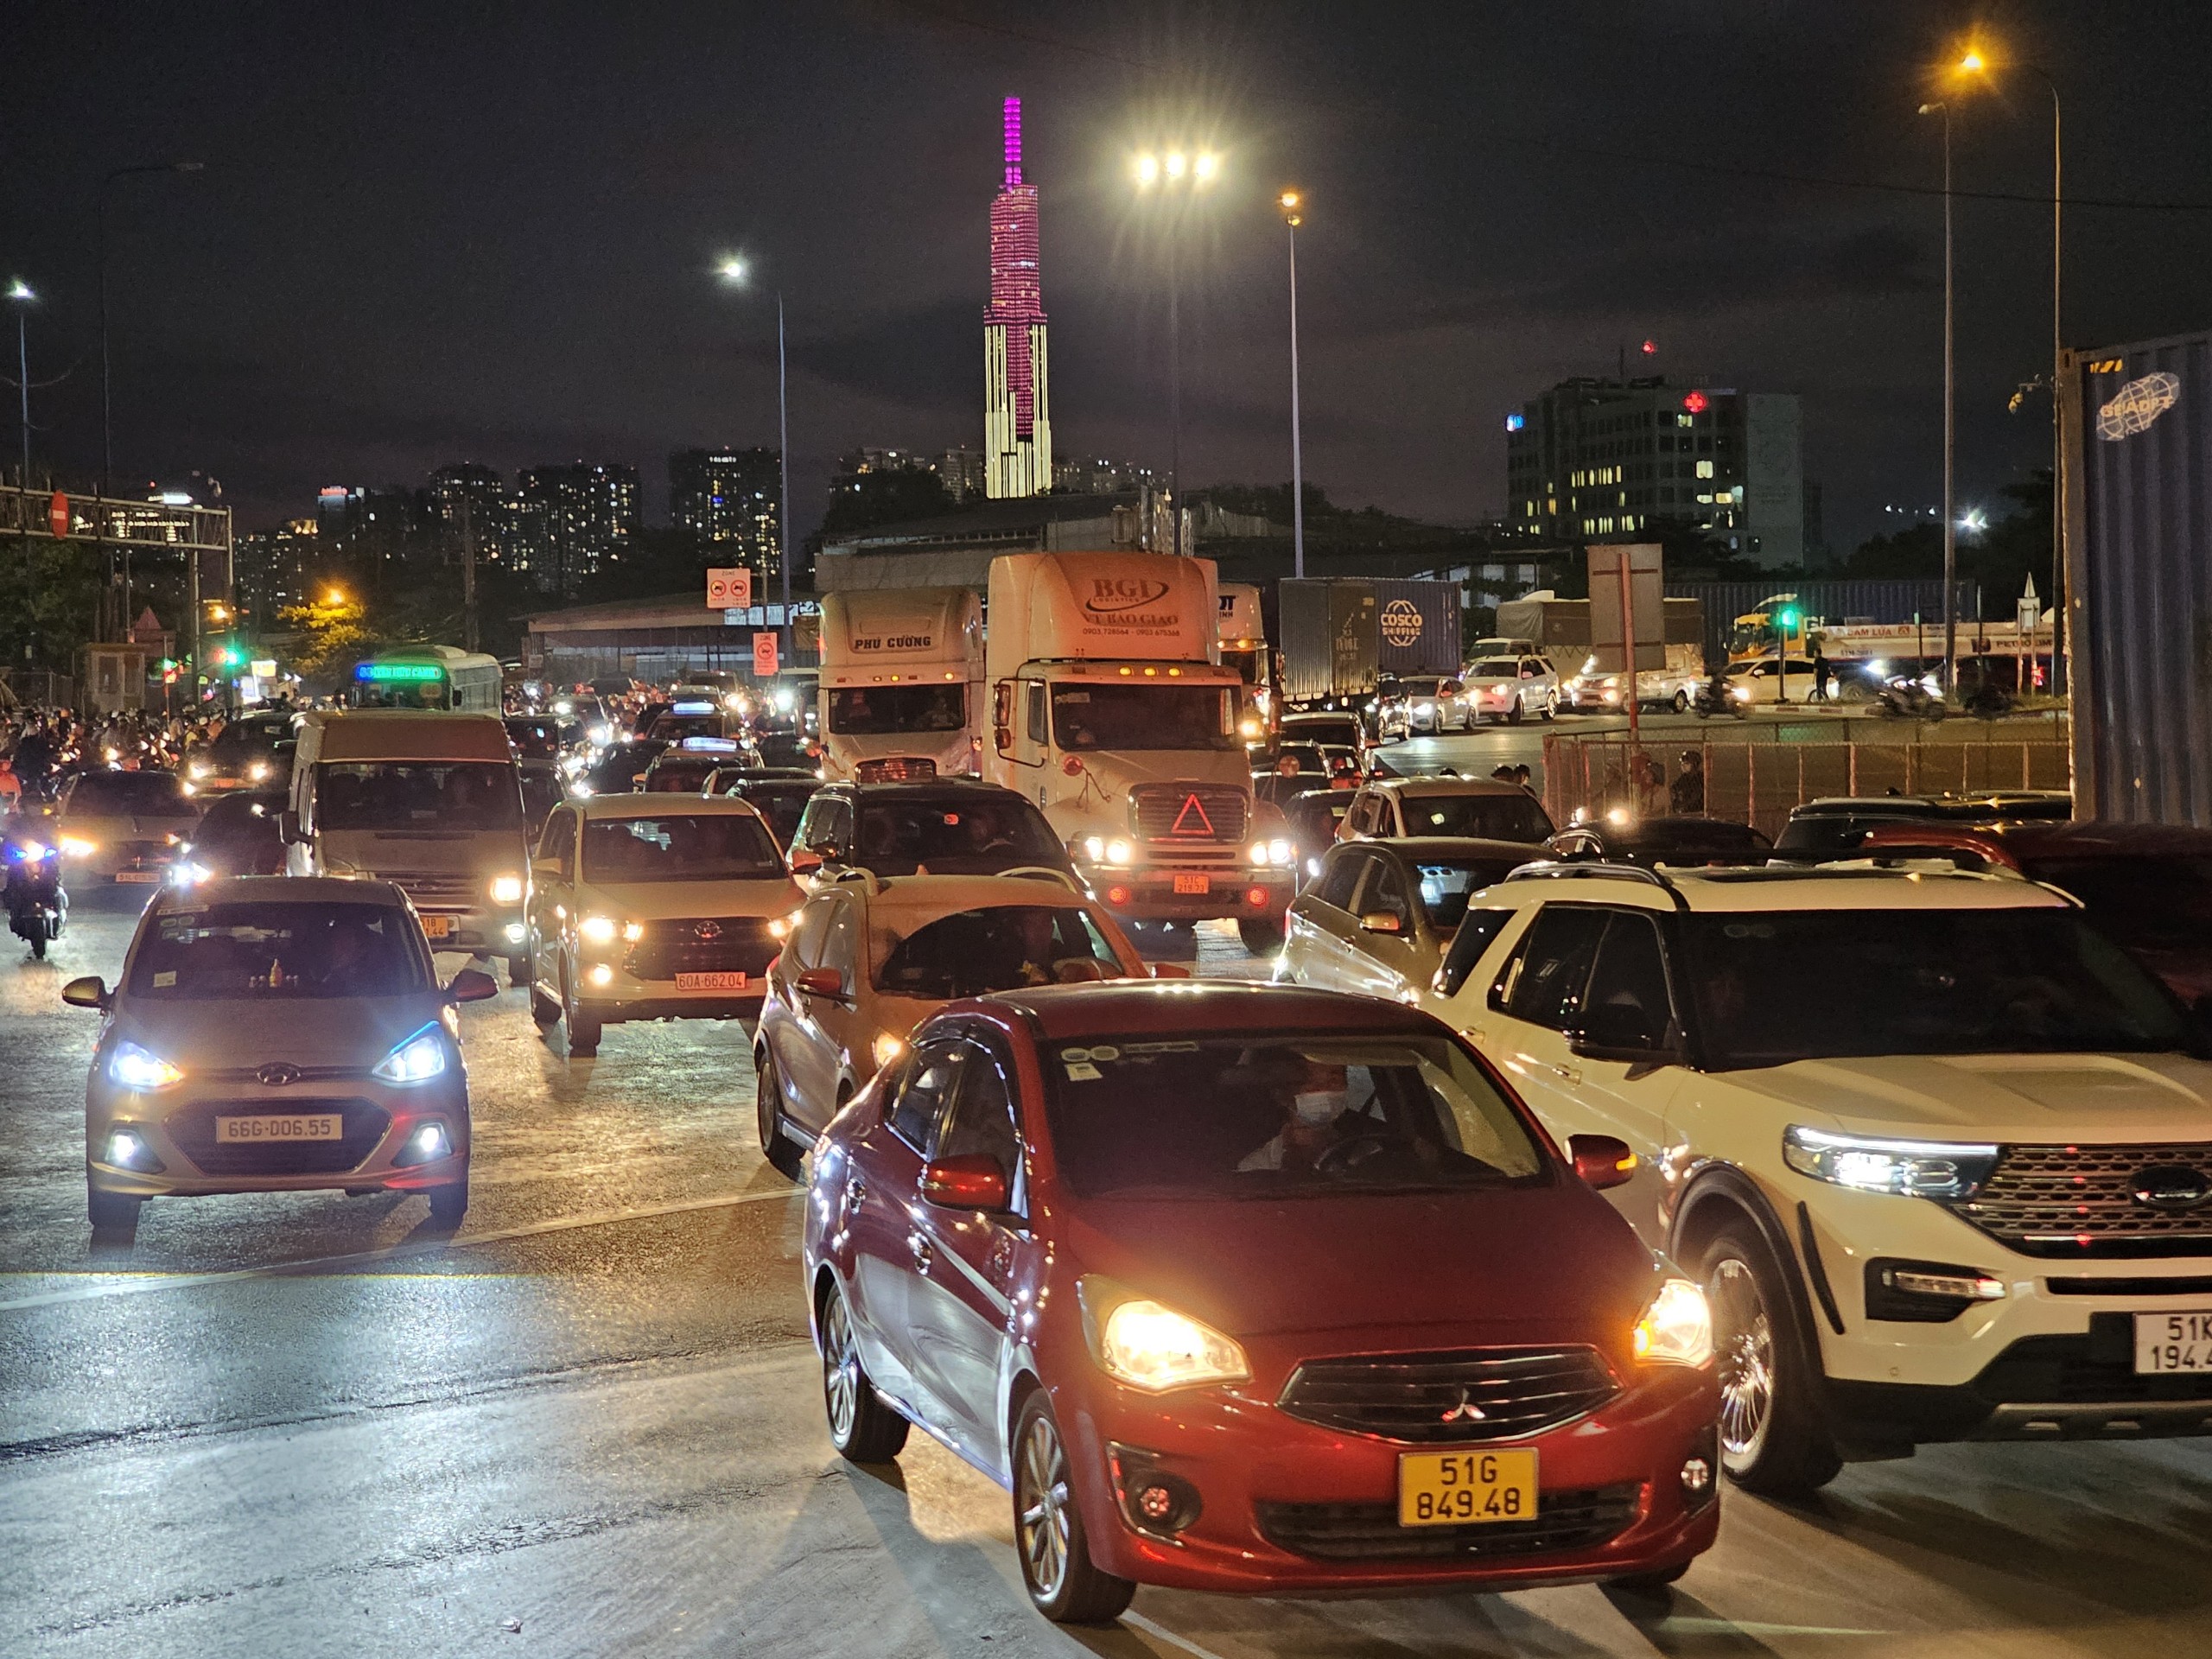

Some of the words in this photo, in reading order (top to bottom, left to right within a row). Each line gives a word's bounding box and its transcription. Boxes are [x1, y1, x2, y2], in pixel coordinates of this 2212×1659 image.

[1381, 613, 1423, 627] COSCO
[1382, 626, 1421, 636] SHIPPING
[887, 634, 931, 648] CƯỜNG
[2168, 1316, 2212, 1341] 51K
[1440, 1455, 1497, 1485] 51G
[1416, 1486, 1521, 1520] 849.48
